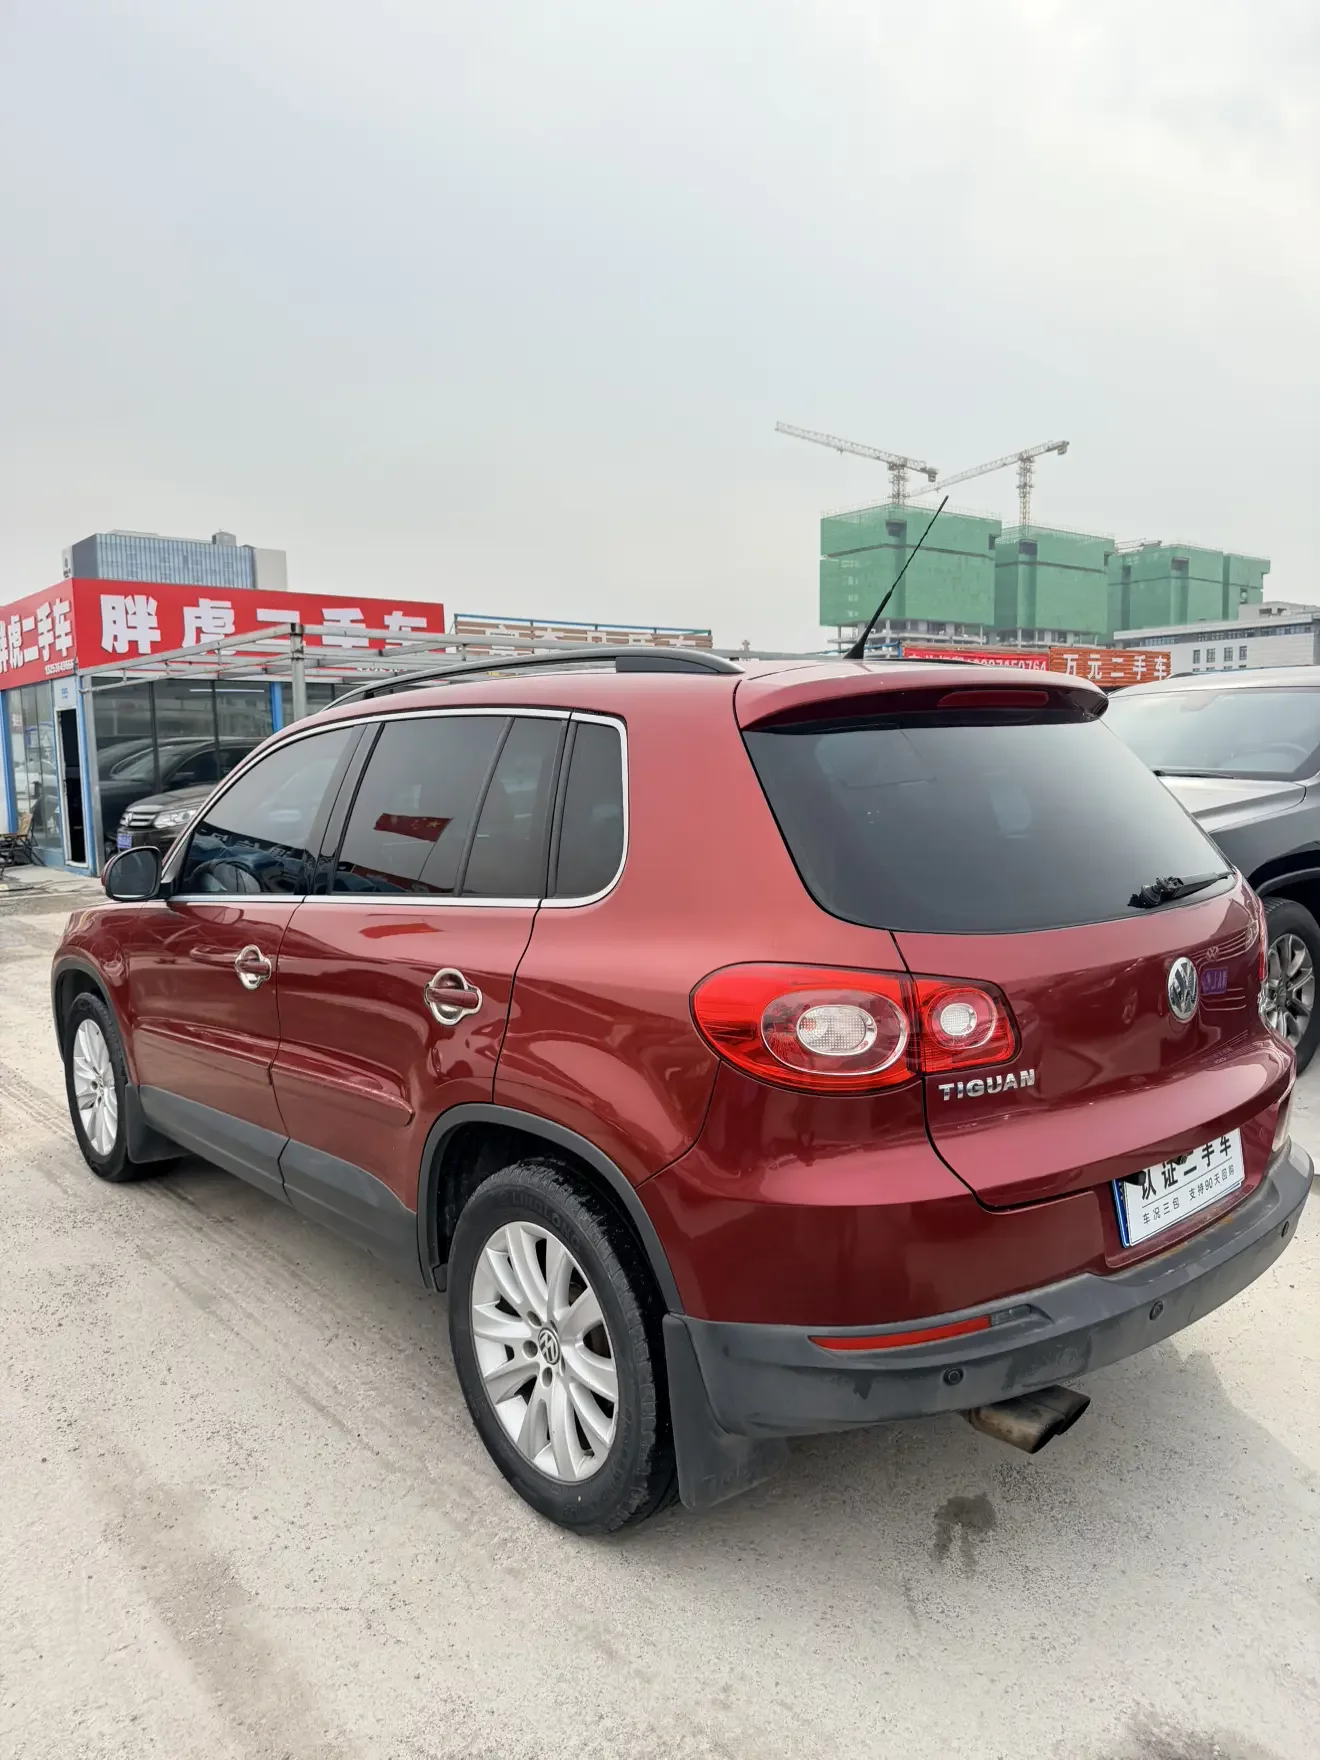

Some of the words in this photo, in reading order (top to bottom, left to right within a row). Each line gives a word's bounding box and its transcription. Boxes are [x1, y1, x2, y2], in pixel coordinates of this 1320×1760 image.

[1063, 653, 1167, 680] 万元二手车
[938, 1068, 1035, 1101] TIGUAN
[1142, 1197, 1180, 1225] 车况三包
[1189, 1164, 1235, 1202] 支持90天回购
